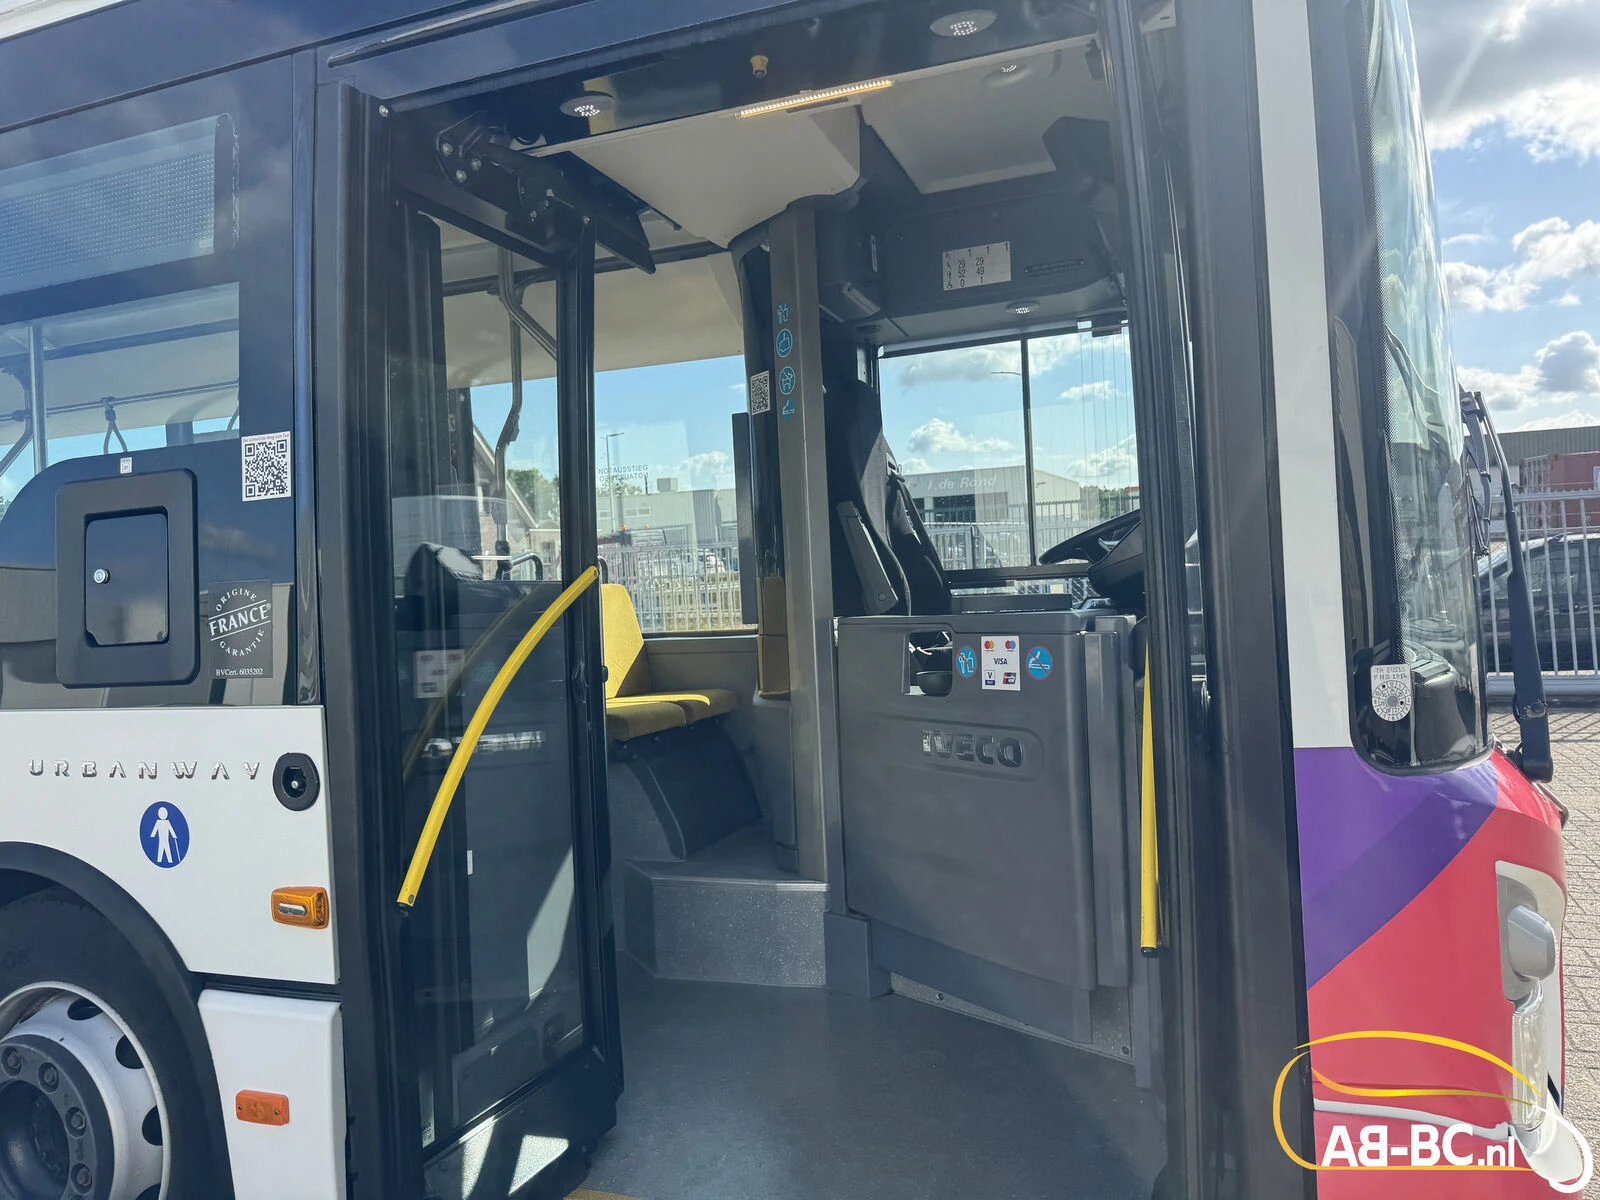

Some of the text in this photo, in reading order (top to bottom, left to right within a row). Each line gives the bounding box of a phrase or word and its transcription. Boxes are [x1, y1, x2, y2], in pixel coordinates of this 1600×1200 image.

[957, 256, 984, 269] 29 29
[957, 266, 985, 278] 52 49
[598, 464, 648, 475] NOTAUSSTIEG
[938, 478, 955, 490] de
[960, 473, 997, 489] Rond
[215, 587, 257, 612] ORIGINE
[219, 629, 265, 657] GARANTIE
[993, 657, 1008, 665] VISA
[921, 728, 1024, 769] IVECO
[28, 759, 260, 780] URBANWAY
